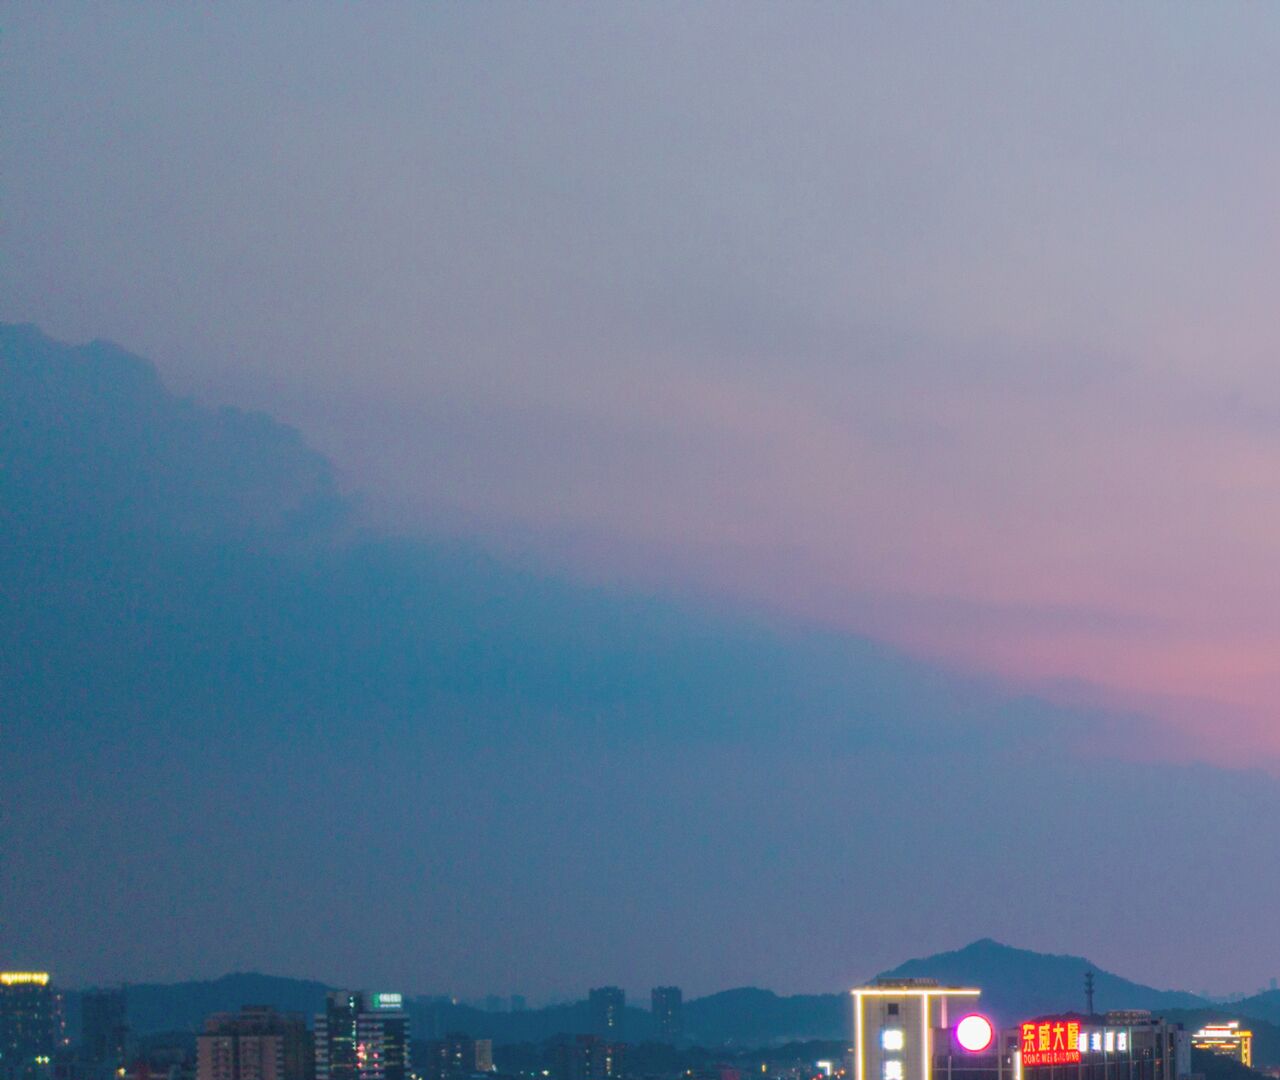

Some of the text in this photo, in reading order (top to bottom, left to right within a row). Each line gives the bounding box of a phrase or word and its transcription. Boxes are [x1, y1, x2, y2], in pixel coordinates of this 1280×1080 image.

[1022, 1022, 1079, 1052] 东威大厦
[1023, 1053, 1041, 1065] DONG
[1042, 1052, 1053, 1064] WEI
